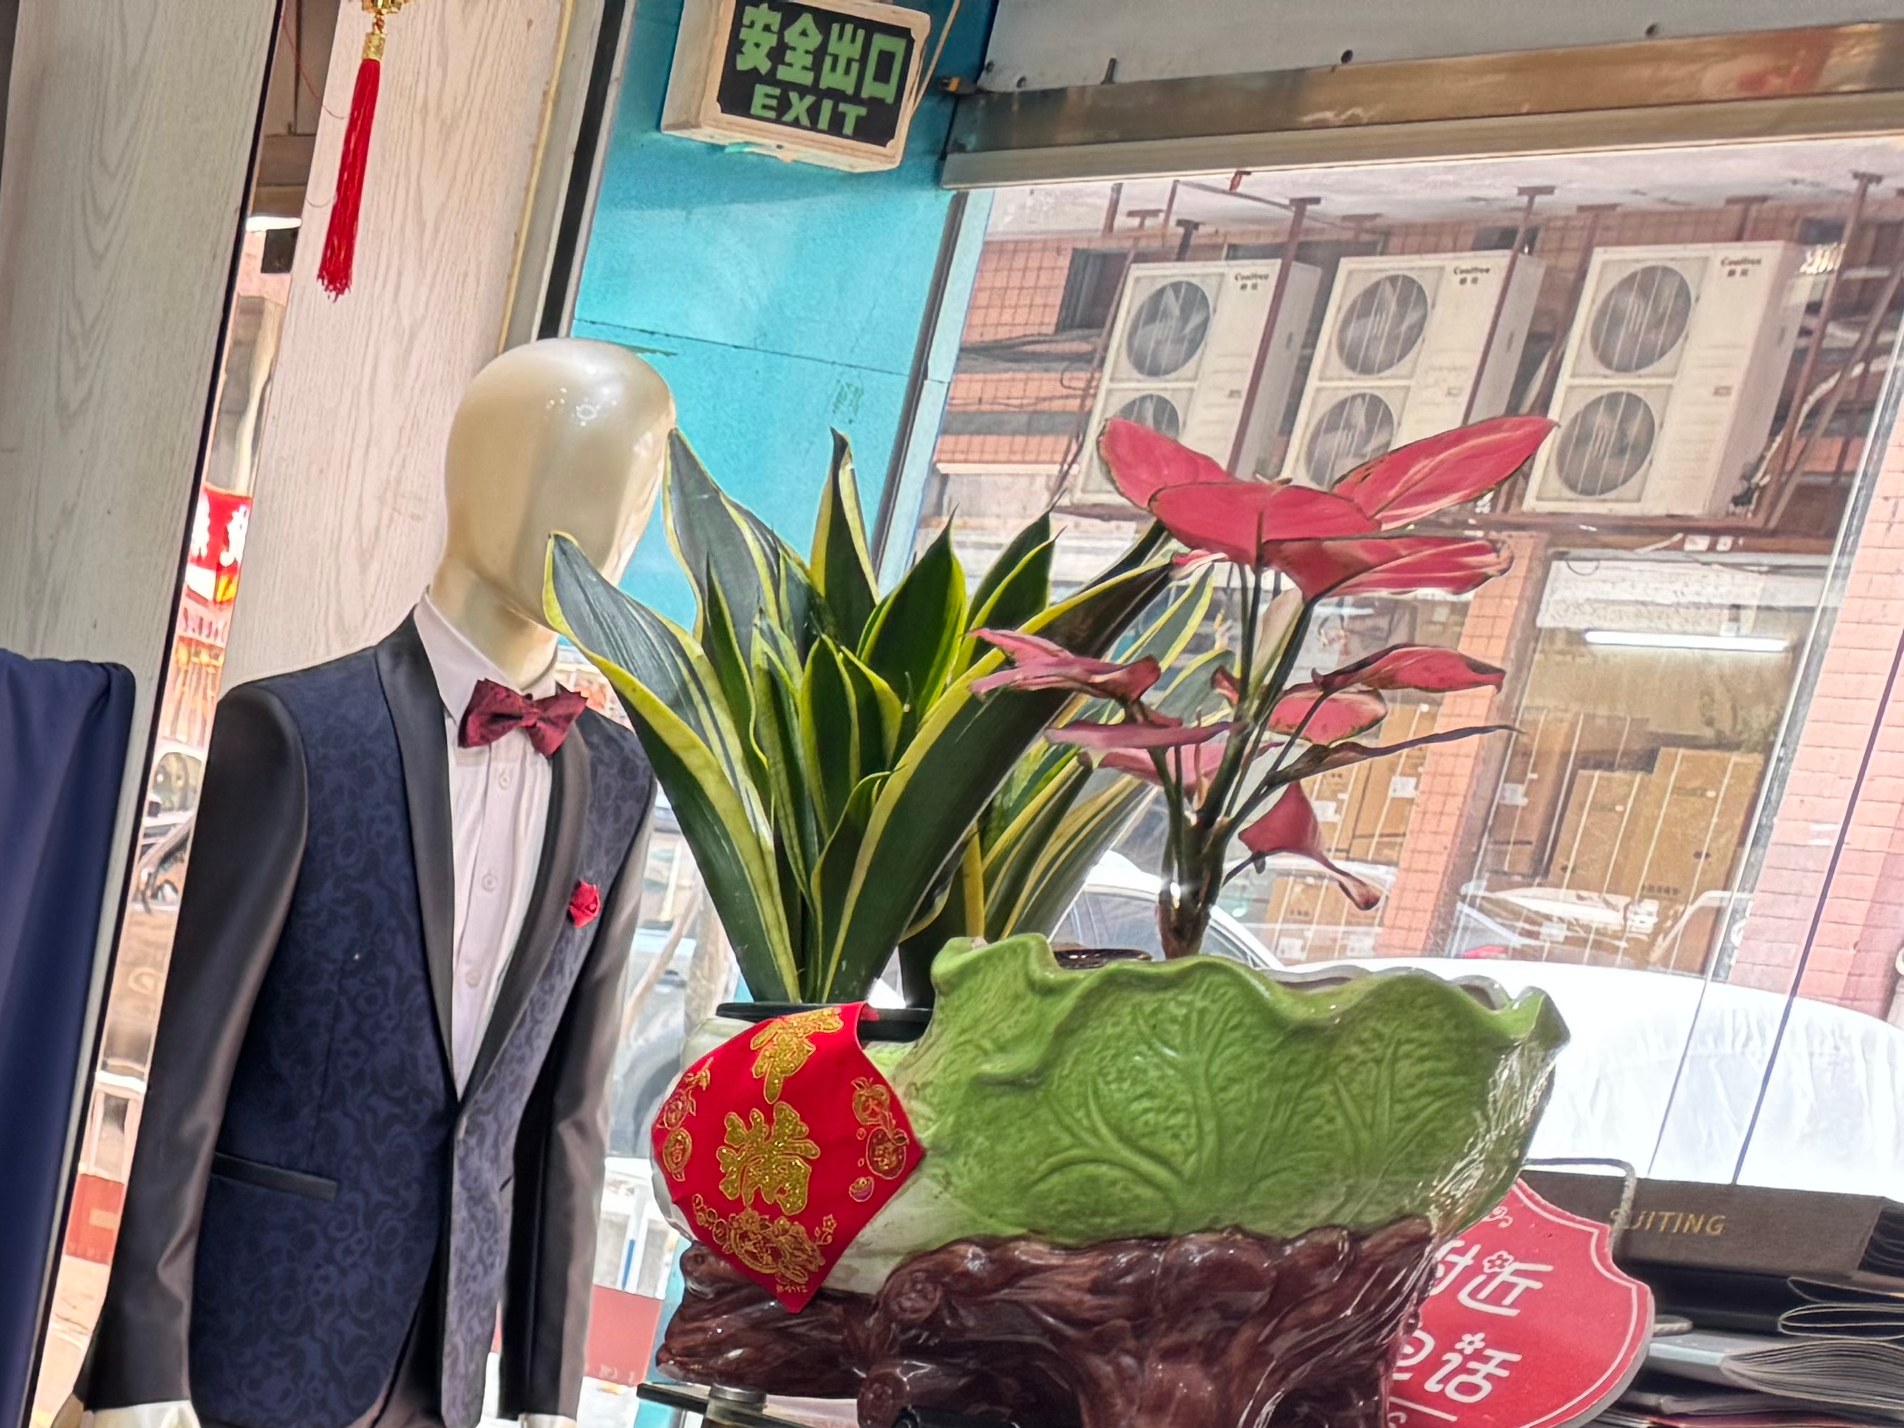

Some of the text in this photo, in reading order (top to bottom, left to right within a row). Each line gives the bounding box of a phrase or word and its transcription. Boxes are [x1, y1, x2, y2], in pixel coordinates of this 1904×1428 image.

[736, 3, 907, 105] 安全出口
[750, 85, 869, 136] EXIT
[1610, 1208, 1727, 1237] UITING
